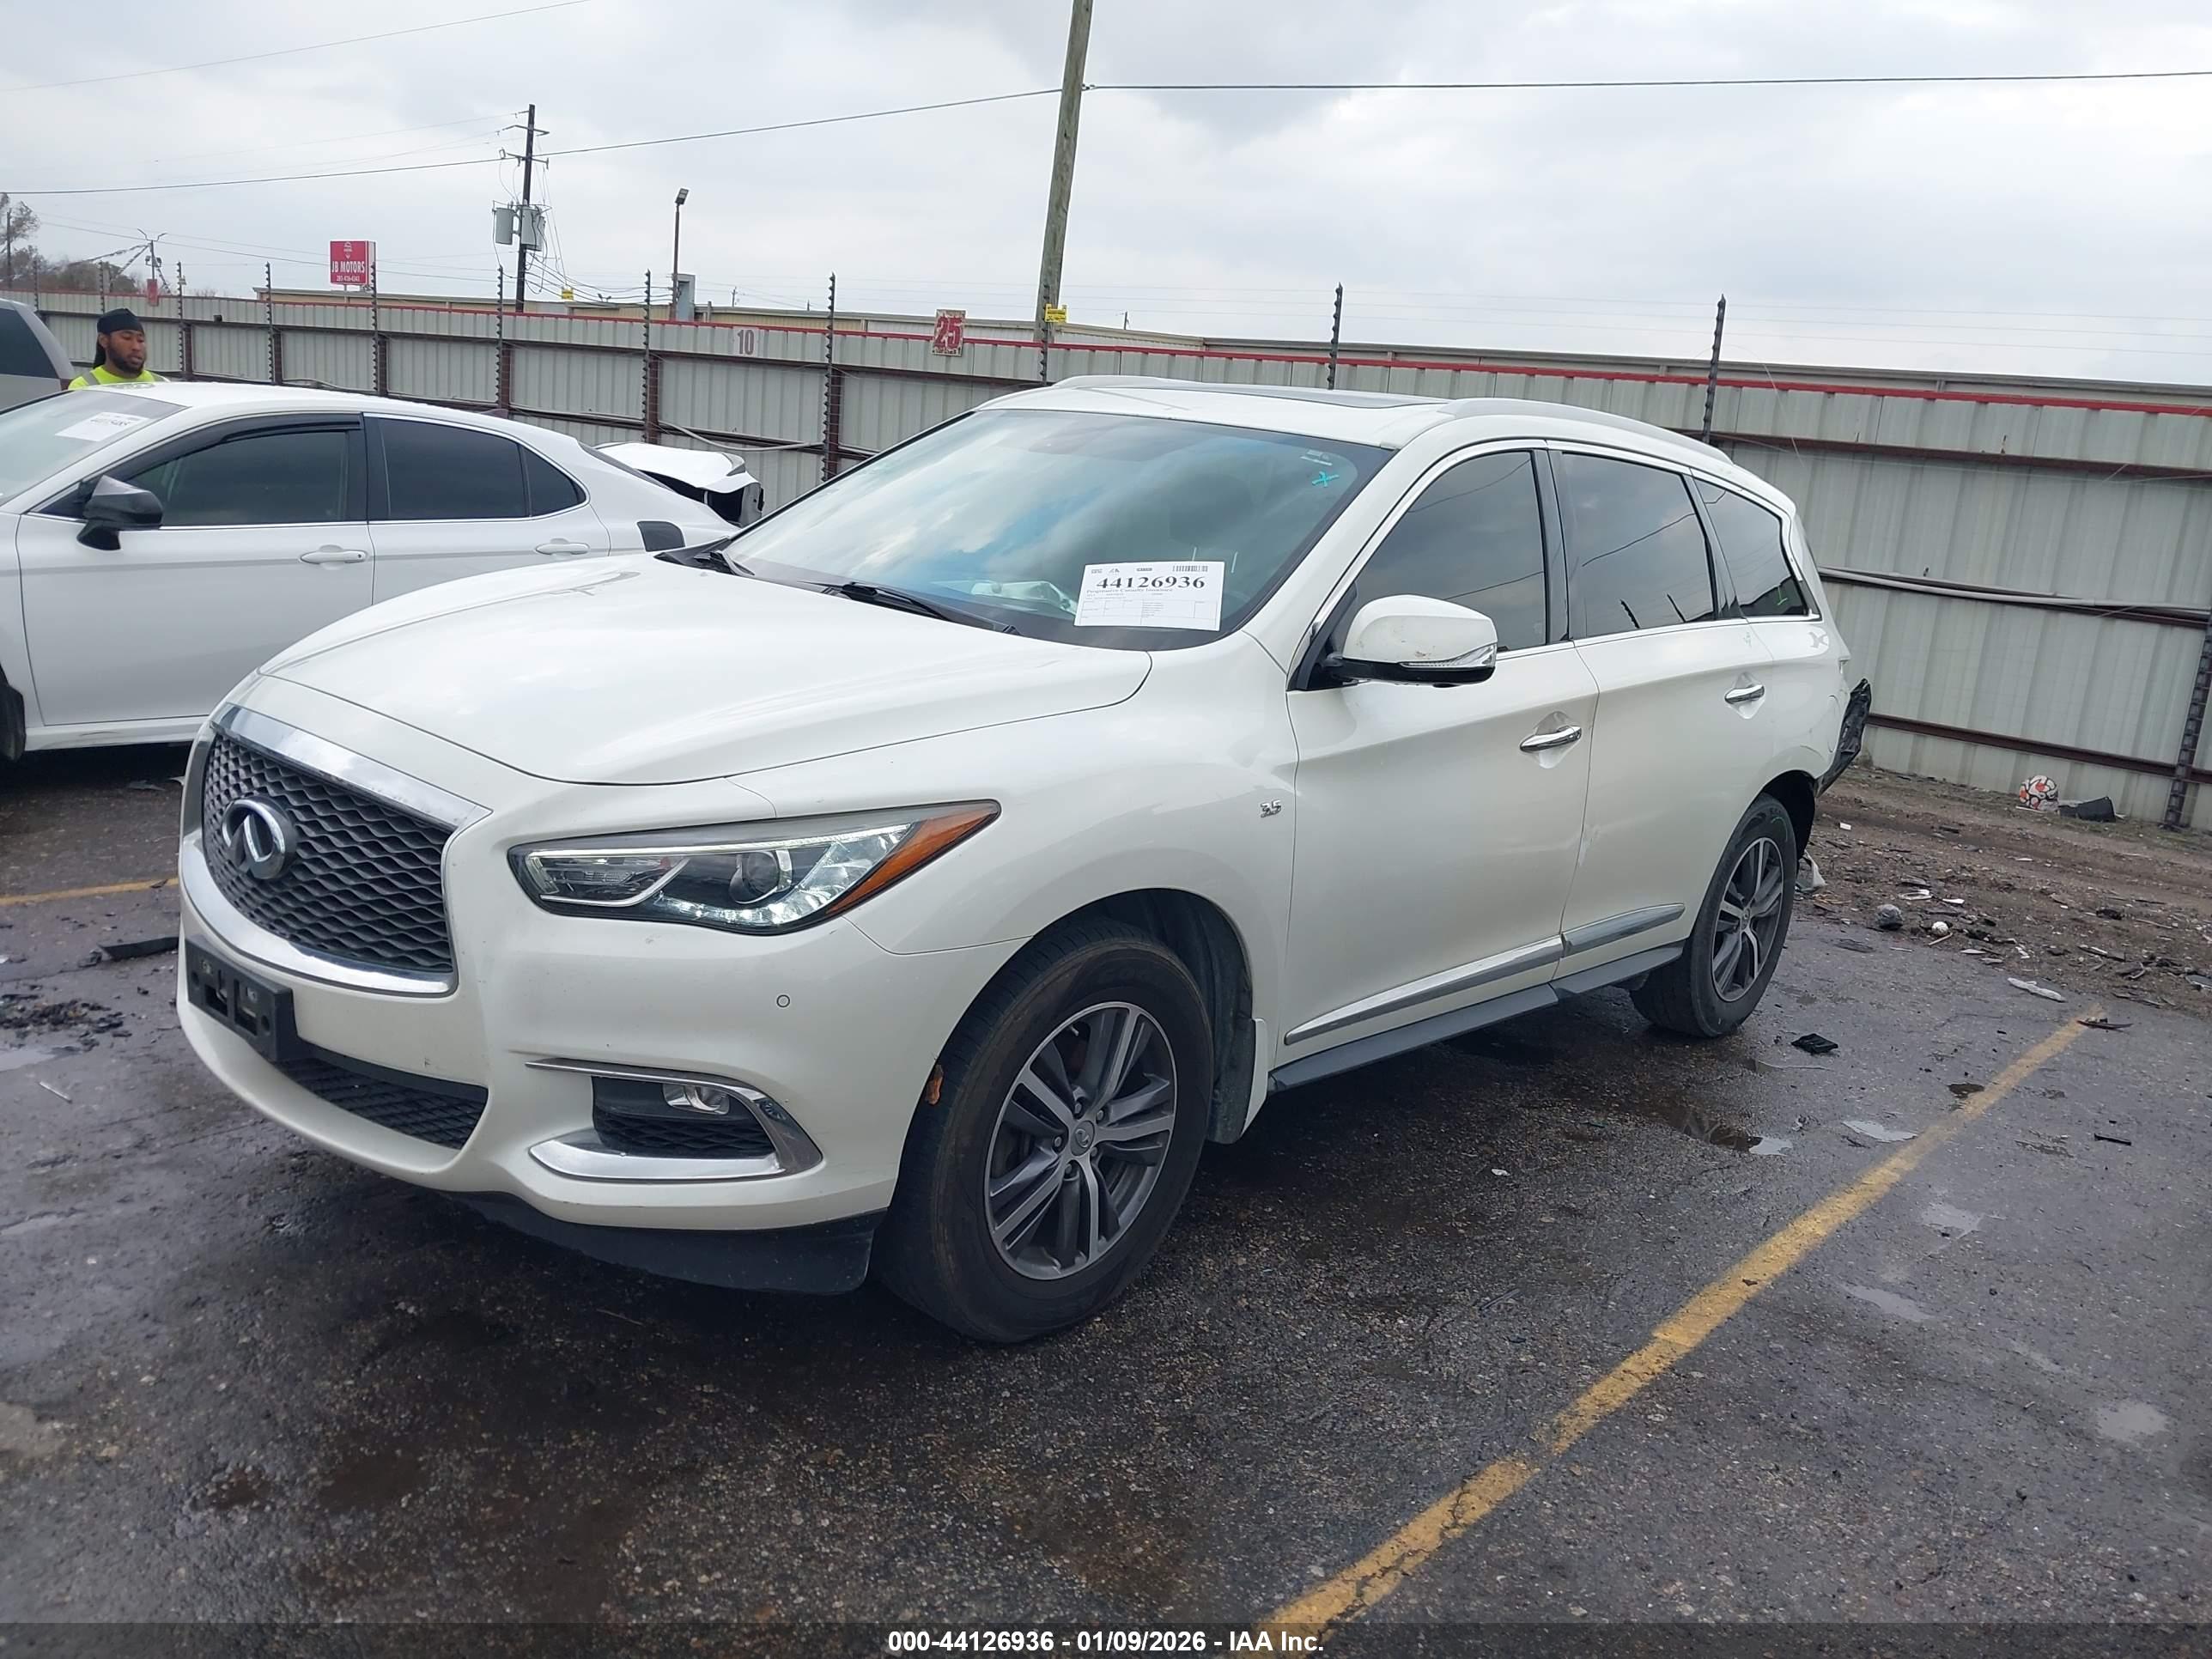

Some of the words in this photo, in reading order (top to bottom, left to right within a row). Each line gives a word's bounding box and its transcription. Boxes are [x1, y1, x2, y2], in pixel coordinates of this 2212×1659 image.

[331, 261, 339, 273] JB
[340, 261, 365, 273] MOTORS
[933, 315, 963, 349] 25
[737, 329, 755, 355] 10
[1097, 576, 1206, 589] 44126936
